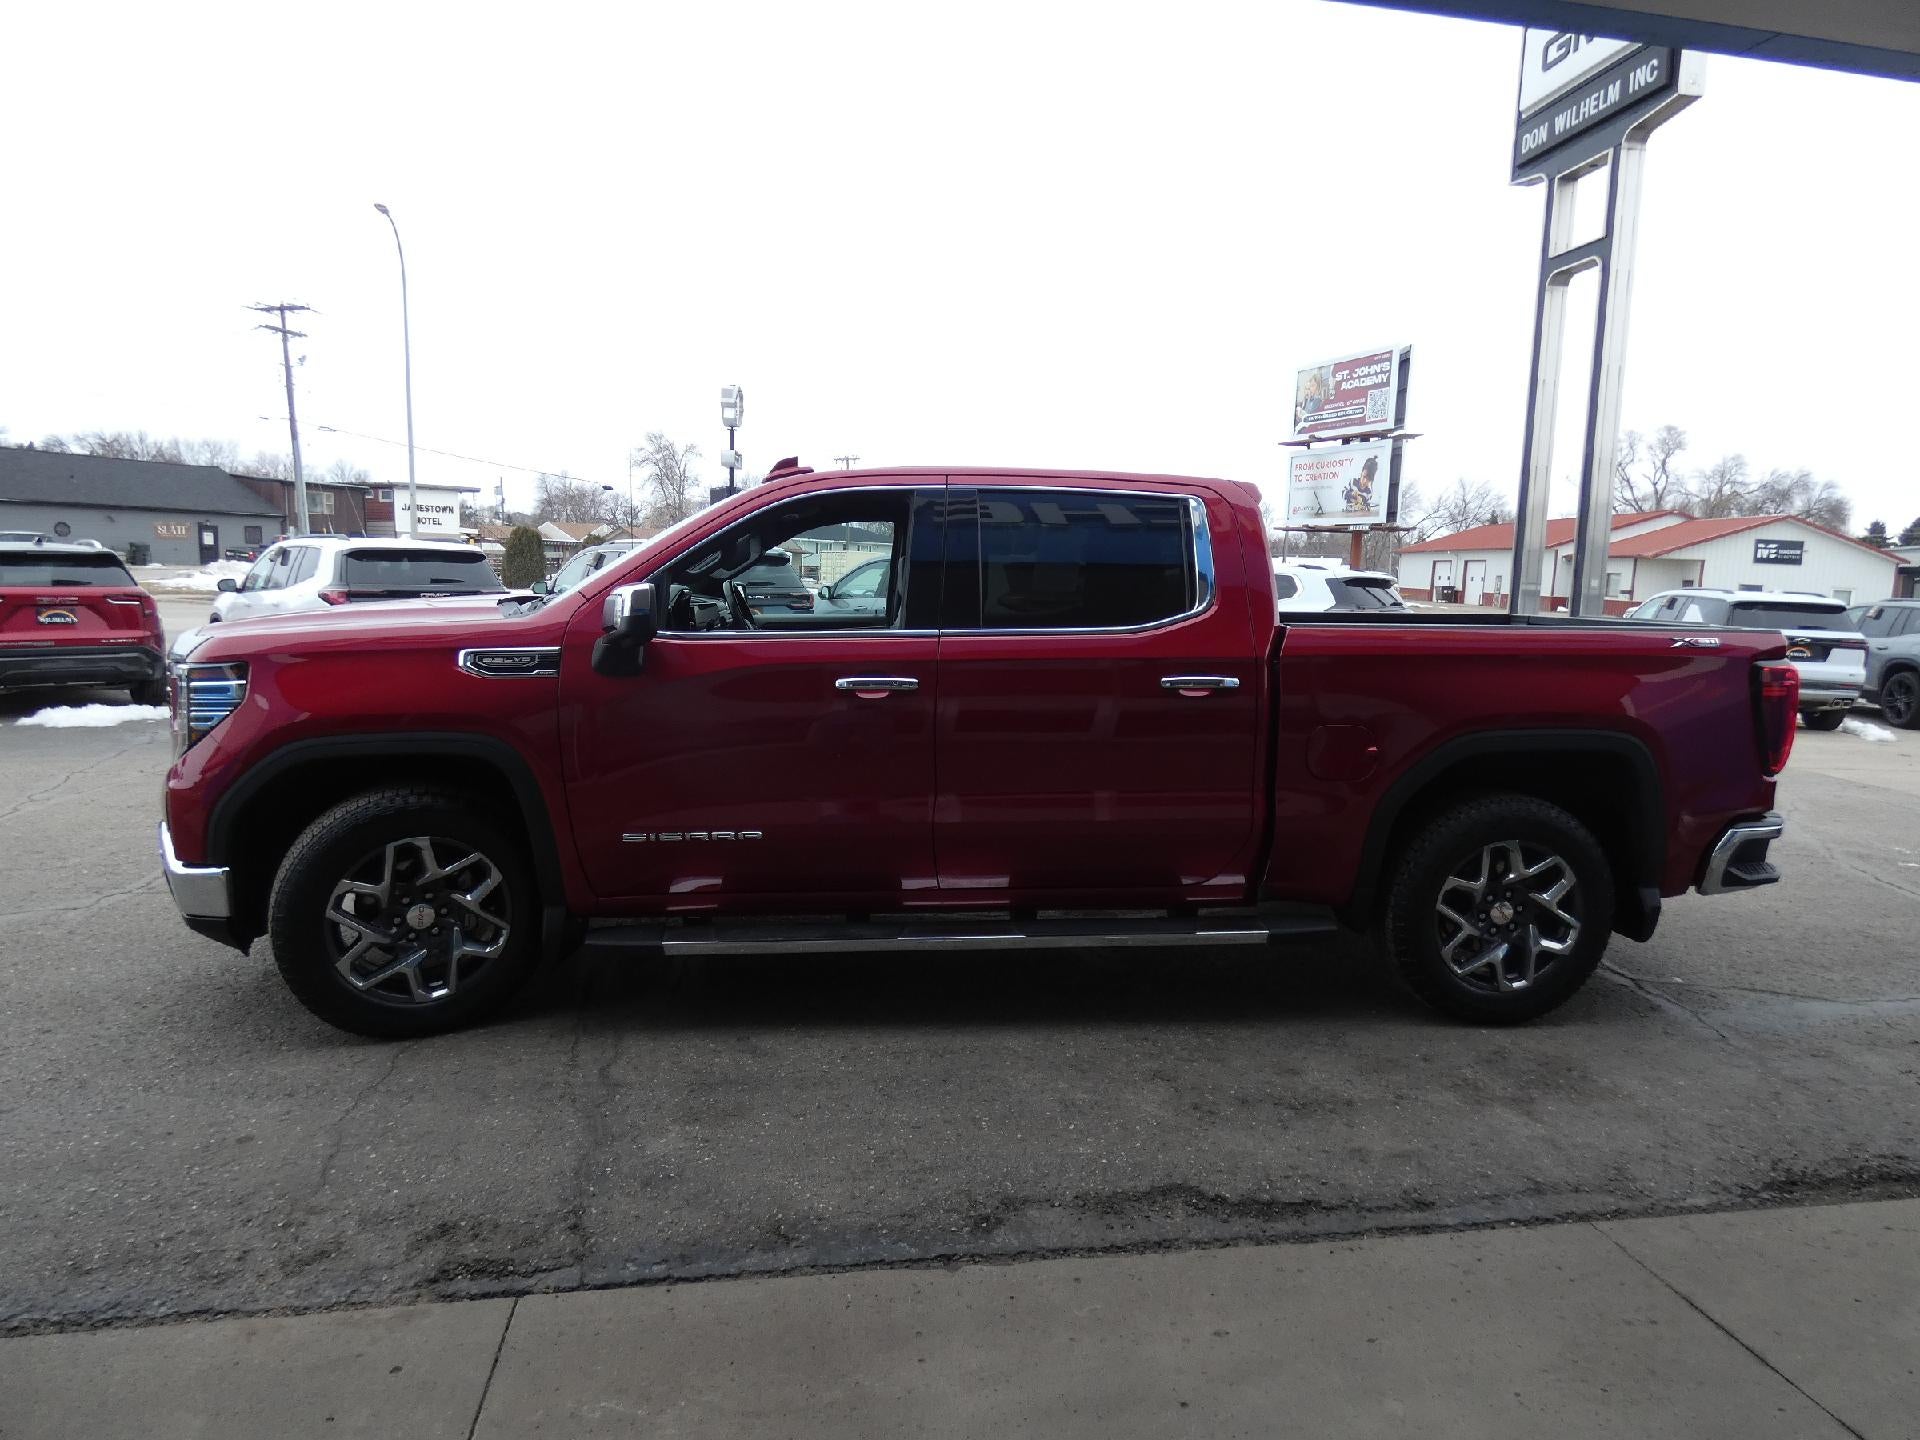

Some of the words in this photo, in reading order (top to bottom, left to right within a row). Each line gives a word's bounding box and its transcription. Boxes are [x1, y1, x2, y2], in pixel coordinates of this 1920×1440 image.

[1521, 122, 1548, 154] DON
[1554, 80, 1621, 135] WILHELM
[1629, 58, 1659, 94] INC
[1335, 370, 1350, 381] ST.
[1353, 362, 1390, 378] JOHN'S
[1340, 373, 1390, 390] ACADEMY
[1295, 462, 1314, 471] FROM
[1316, 458, 1354, 470] CURIOSITY
[1294, 474, 1303, 482] TO
[1305, 472, 1340, 482] CREATION
[402, 503, 454, 514] JESTOWN
[621, 831, 763, 842] SIERRA
